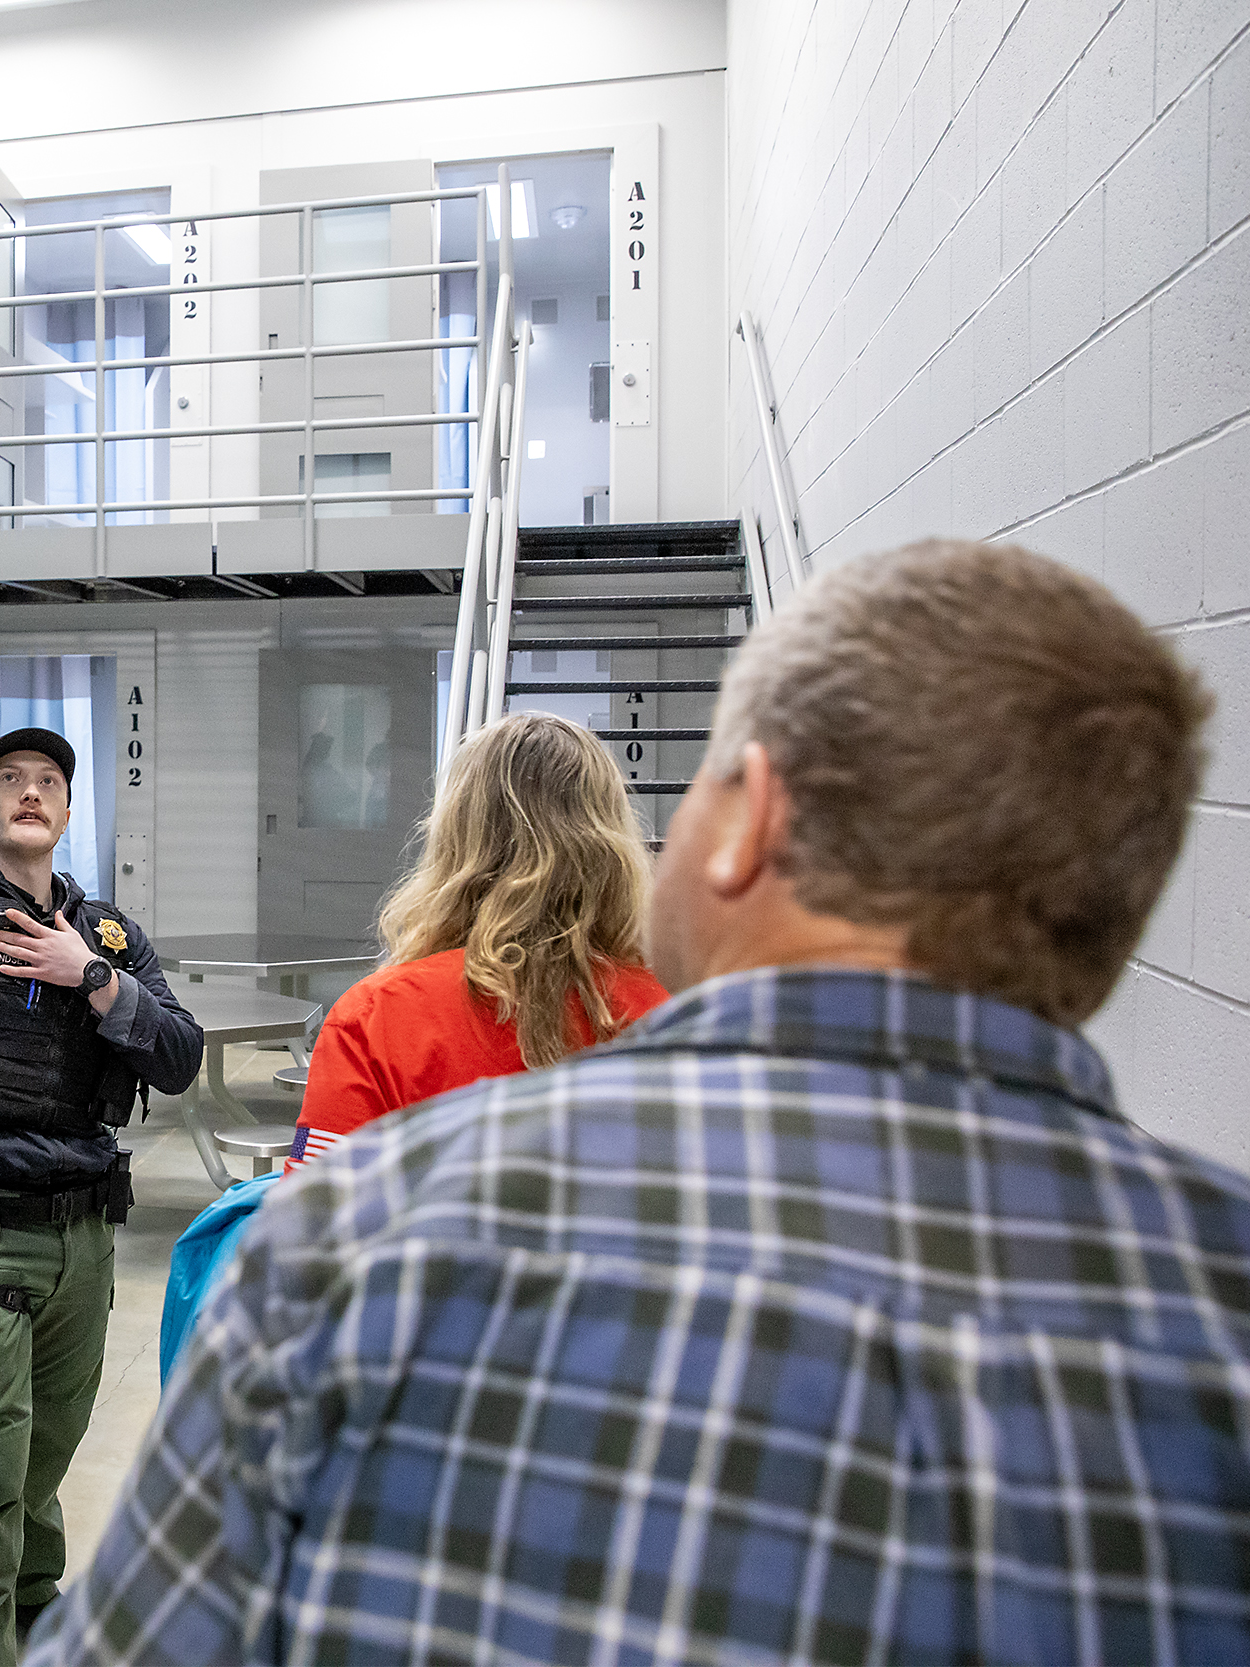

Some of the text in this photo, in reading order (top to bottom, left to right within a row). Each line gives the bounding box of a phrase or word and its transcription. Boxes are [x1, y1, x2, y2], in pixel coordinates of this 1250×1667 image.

[182, 220, 199, 320] A202
[627, 181, 646, 291] A201
[127, 685, 144, 787] A102
